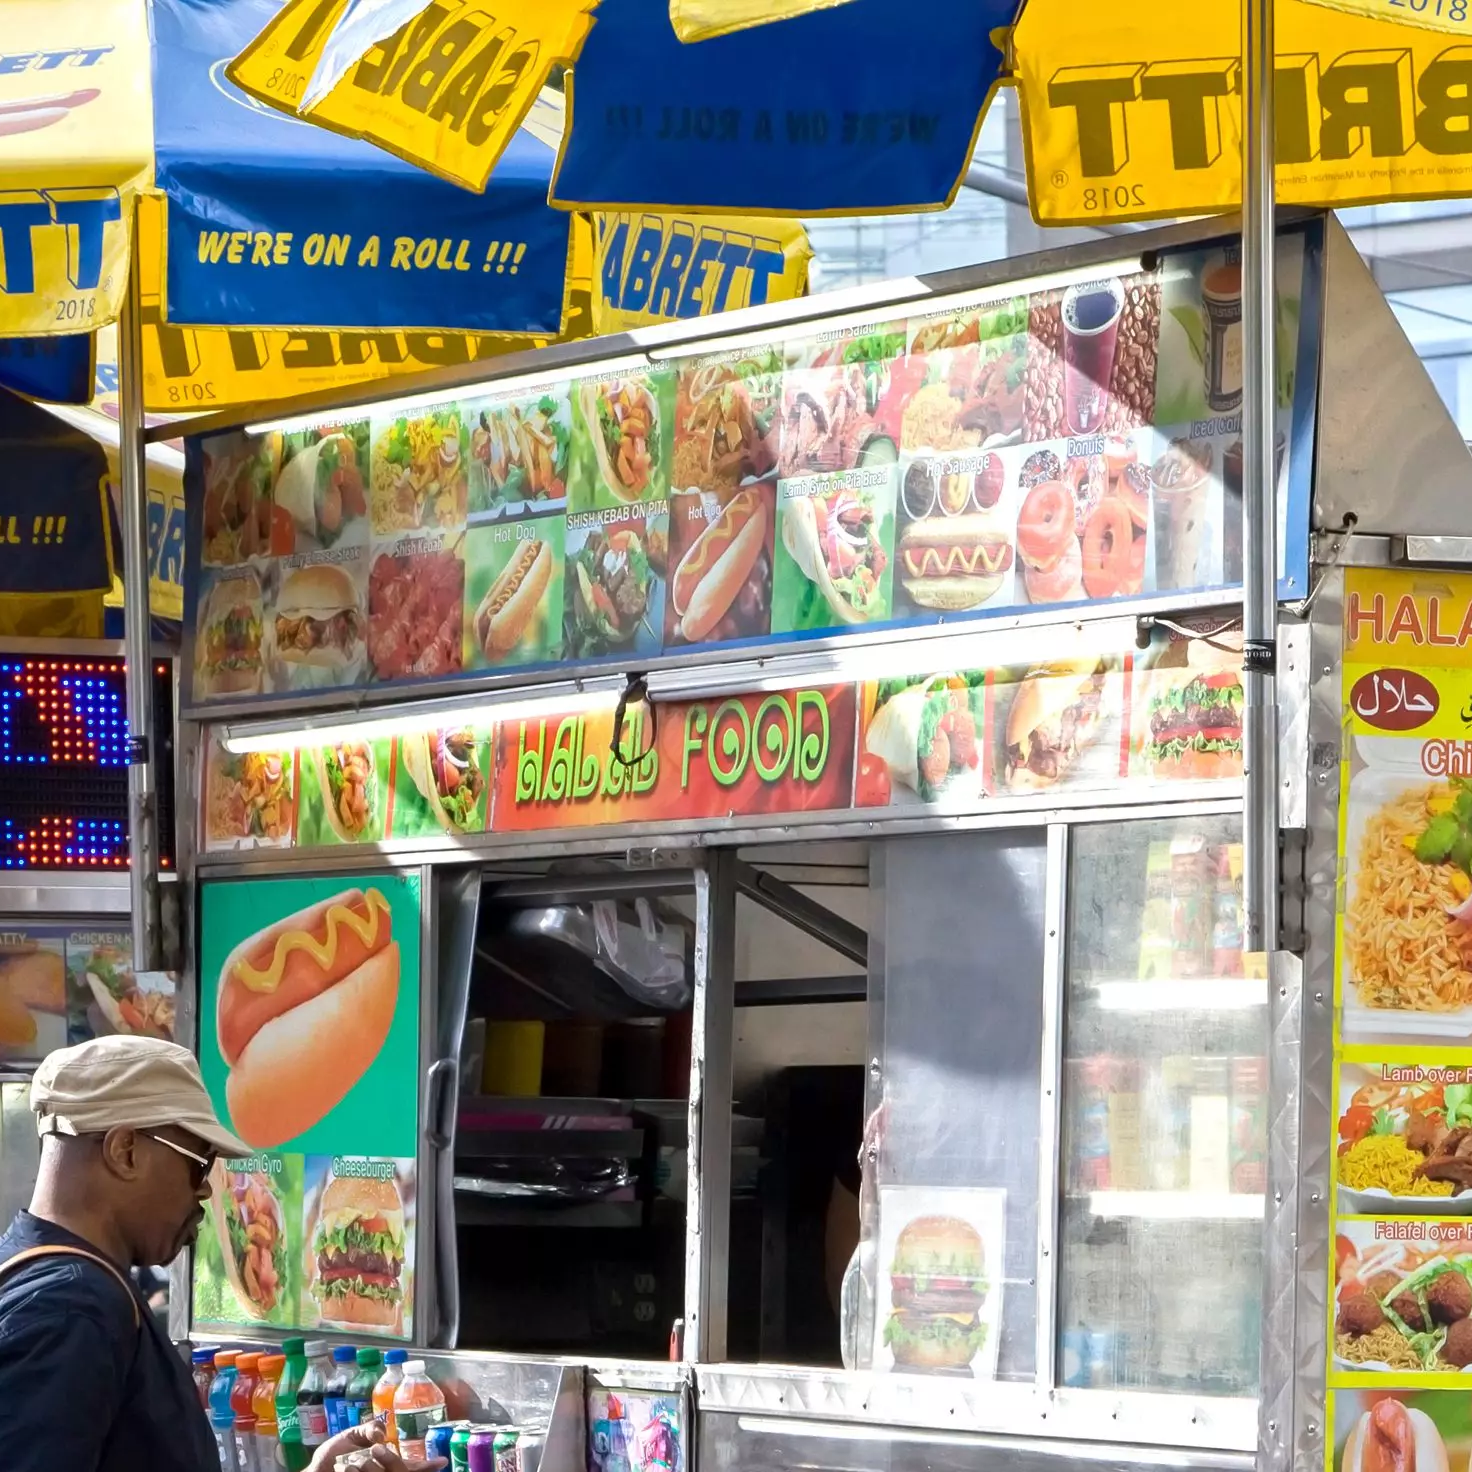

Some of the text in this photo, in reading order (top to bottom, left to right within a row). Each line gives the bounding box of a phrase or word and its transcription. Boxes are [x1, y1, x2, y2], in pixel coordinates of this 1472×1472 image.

[197, 231, 527, 274] WE'RE ON A ROLL !!!
[600, 213, 785, 318] ABRETT
[55, 298, 97, 322] 2018
[1067, 437, 1105, 457] Donuts
[926, 455, 990, 478] Hot Sausage
[784, 471, 888, 498] Lamb Gyro on Pita Bread
[567, 501, 668, 530] SHISH KEBAB ON PITA
[31, 515, 68, 545] !!!
[494, 525, 536, 543] Hot Dog
[1356, 674, 1435, 717] حلال
[681, 690, 830, 788] FOOD
[70, 932, 121, 944] CHICKEN
[1381, 1065, 1423, 1084] Lamb
[1427, 1069, 1462, 1084] over
[262, 1158, 283, 1176] Gyro
[332, 1156, 396, 1181] Cheeseburger
[1374, 1222, 1426, 1241] Falafel
[1430, 1227, 1463, 1241] over
